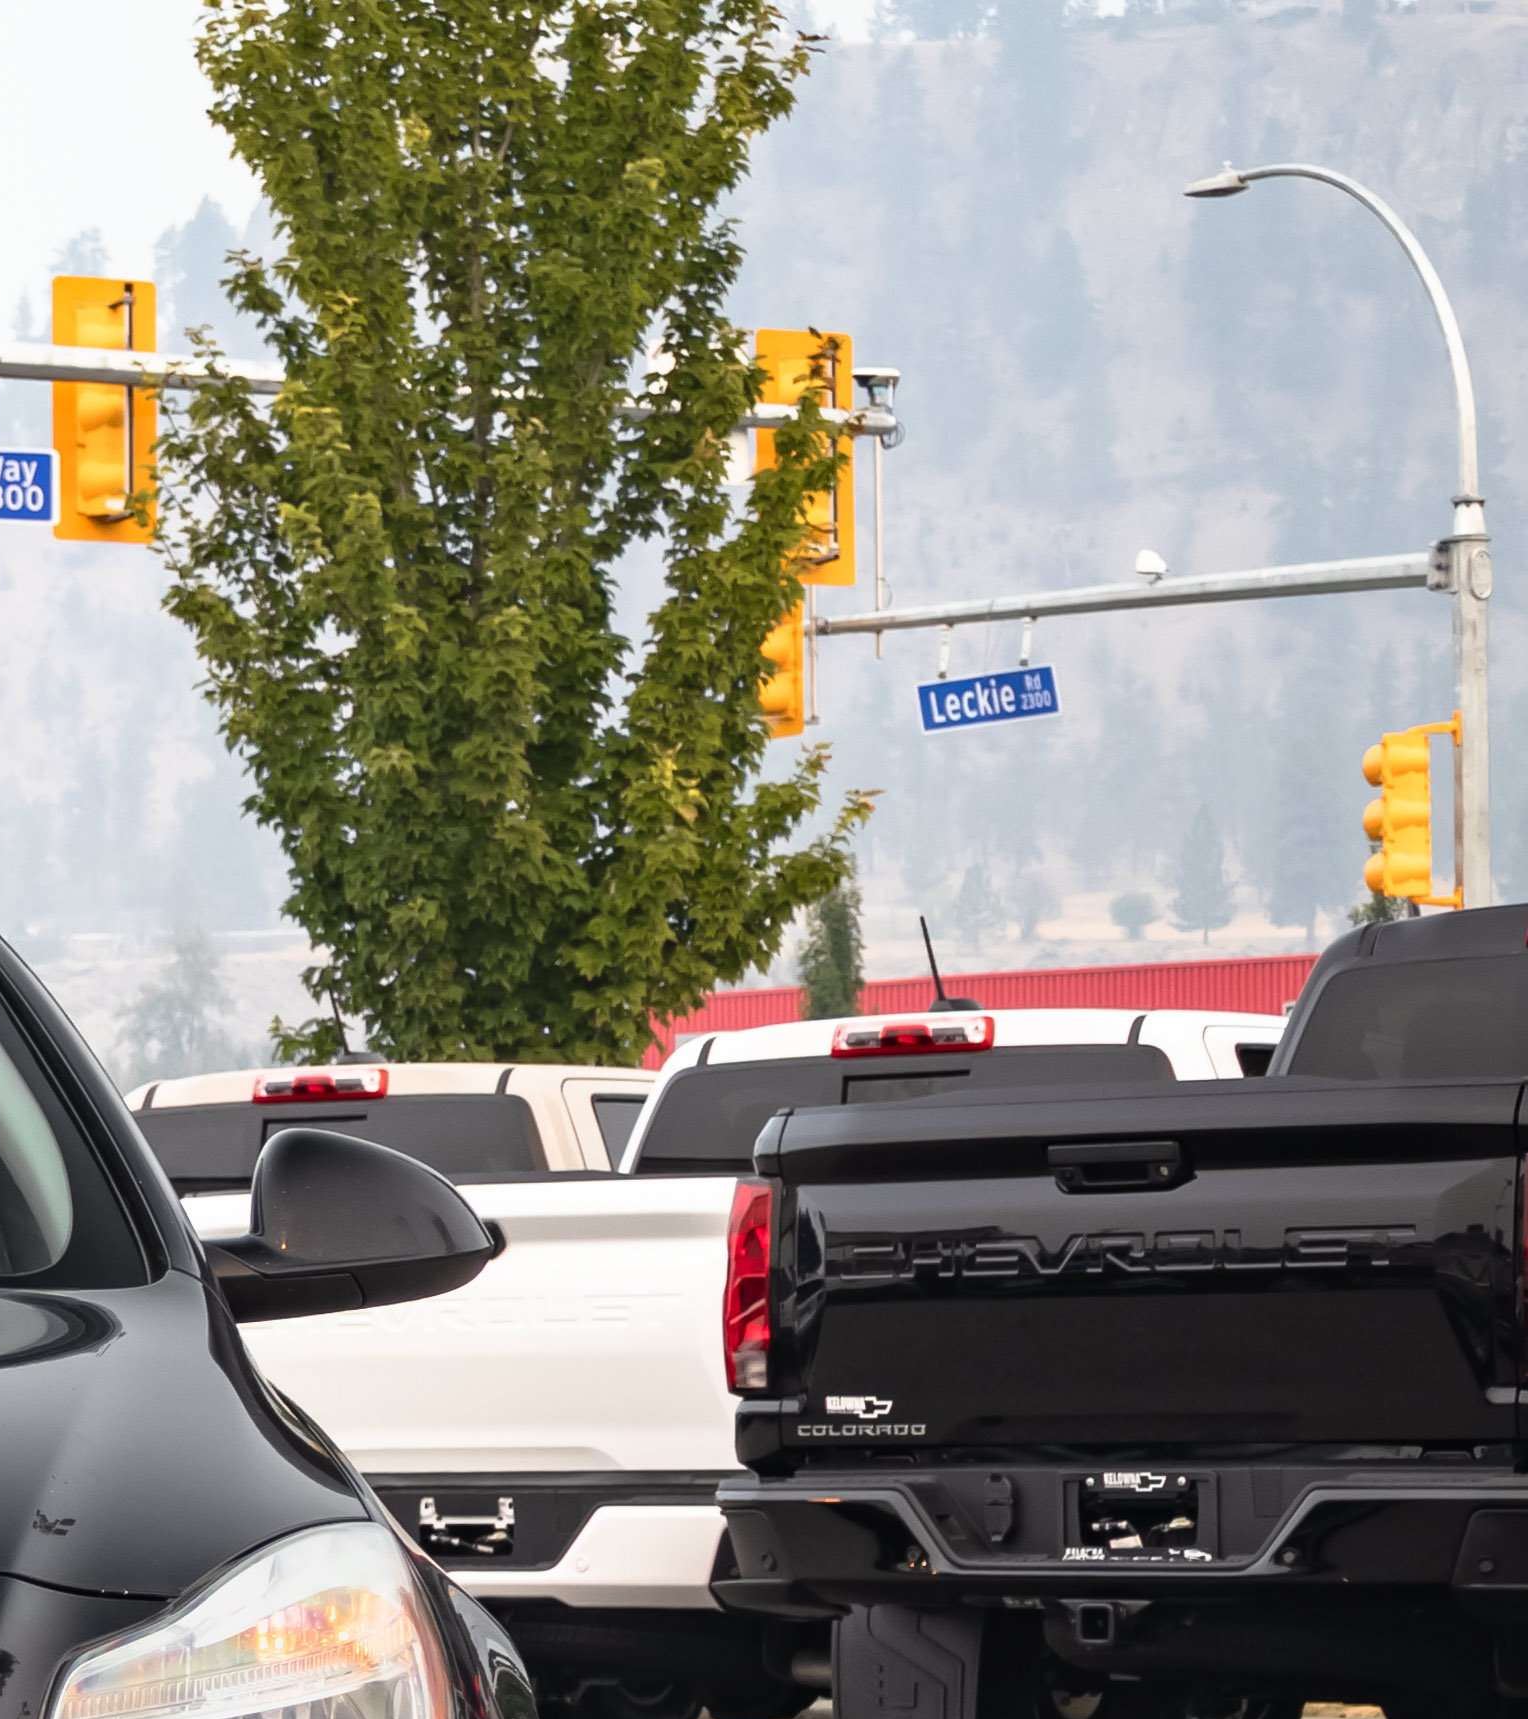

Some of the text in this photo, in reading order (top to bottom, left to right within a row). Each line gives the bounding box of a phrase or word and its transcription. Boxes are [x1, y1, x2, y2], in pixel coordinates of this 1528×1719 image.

[1024, 672, 1042, 691] Rd
[929, 678, 1016, 723] Leckie
[1020, 689, 1052, 711] 2300
[837, 1224, 1417, 1280] CHEVROLET
[797, 1424, 926, 1436] COLORADO
